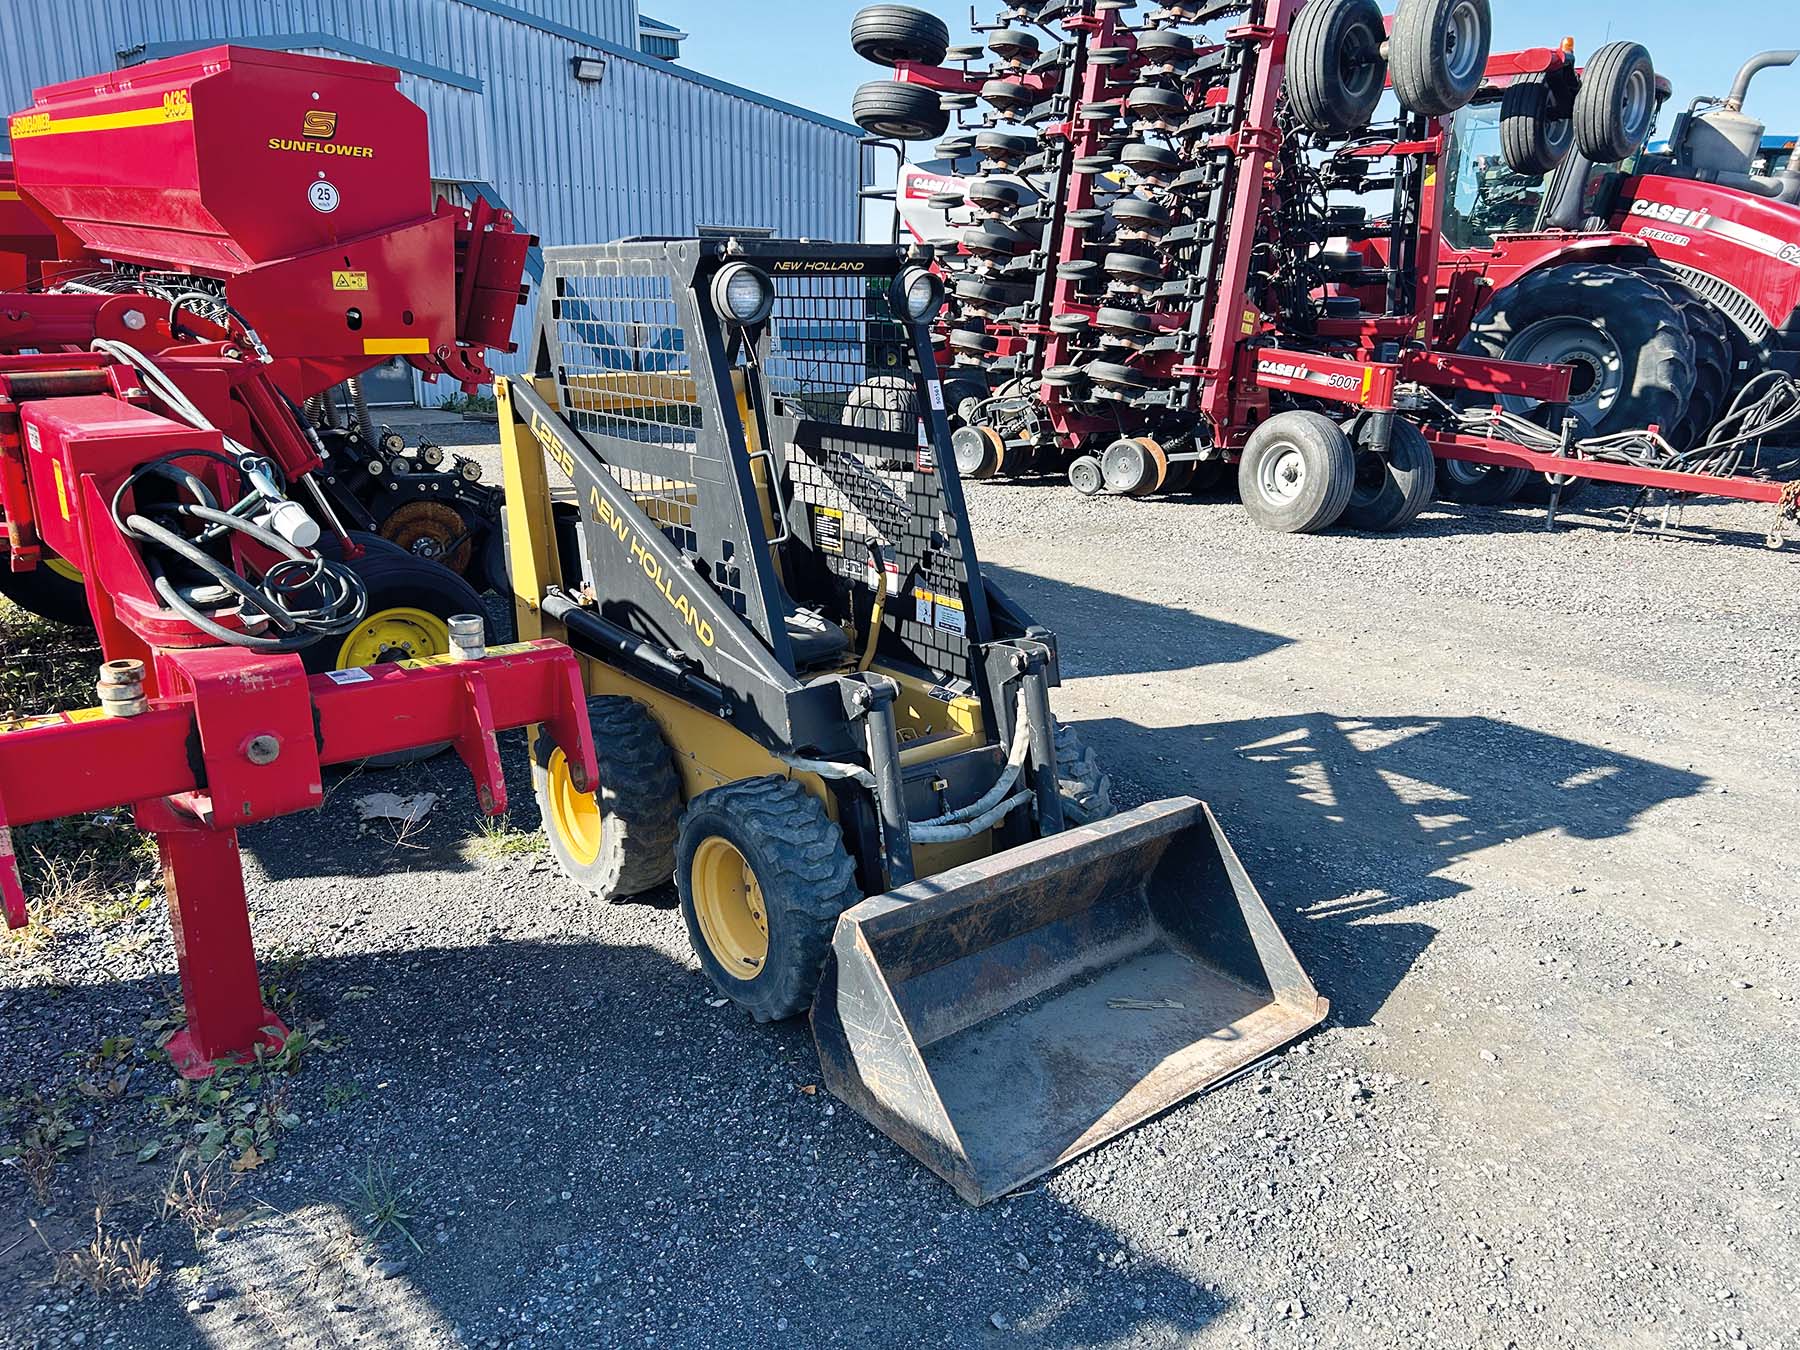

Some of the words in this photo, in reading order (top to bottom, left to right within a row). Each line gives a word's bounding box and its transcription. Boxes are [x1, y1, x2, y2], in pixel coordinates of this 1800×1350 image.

[163, 89, 188, 118] 9435
[268, 138, 374, 158] SUNFLOWER
[317, 187, 331, 201] 25
[1630, 199, 1691, 226] CASE
[1640, 227, 1690, 246] STEIGER
[773, 261, 803, 271] NEW
[804, 262, 865, 271] HOLLAND
[1259, 360, 1296, 378] CASE
[1327, 373, 1361, 391] 500T
[529, 410, 575, 478] L255
[589, 485, 630, 542] NEW
[630, 535, 715, 648] HOLLAND
